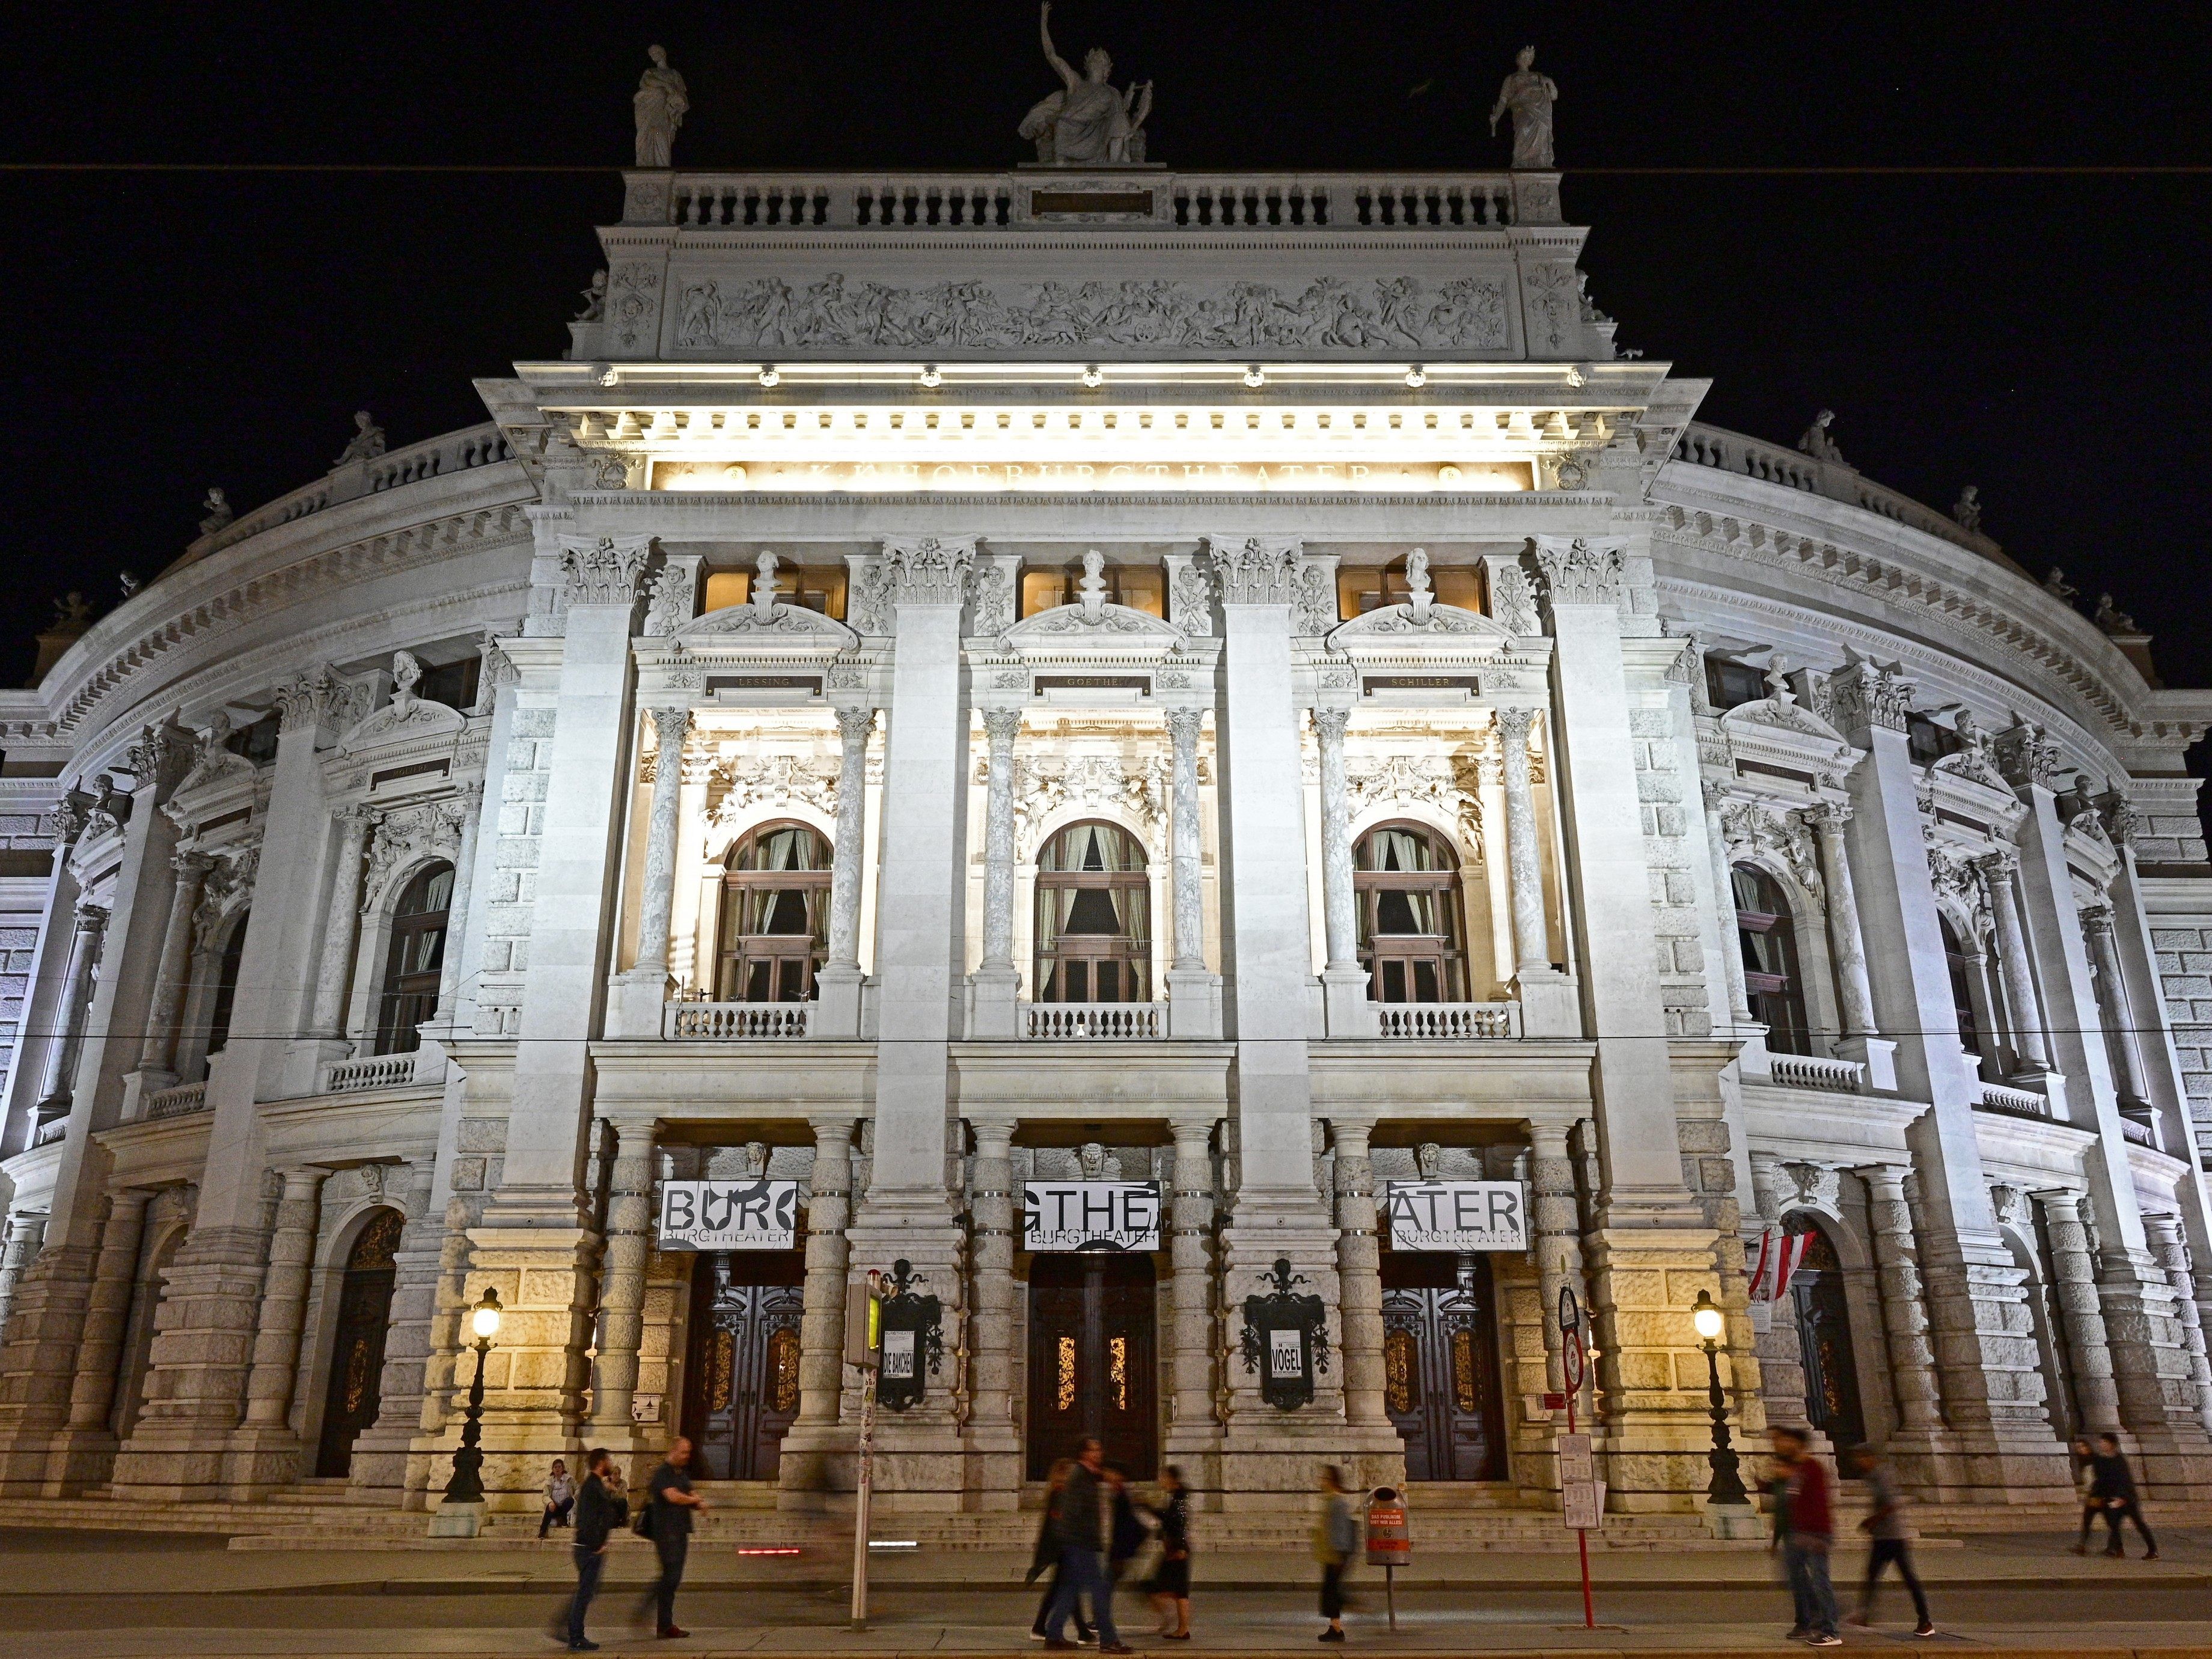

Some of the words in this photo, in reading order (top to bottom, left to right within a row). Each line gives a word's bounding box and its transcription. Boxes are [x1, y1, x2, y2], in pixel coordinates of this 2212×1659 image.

[1391, 1190, 1520, 1232] ATER
[664, 1228, 789, 1242] BURGTHEATER
[1031, 1229, 1155, 1244] BURGTHEATER
[1396, 1229, 1521, 1242] BURGTHEATER
[893, 1352, 914, 1373] BAKCHEN
[1271, 1343, 1301, 1371] VÖGEL
